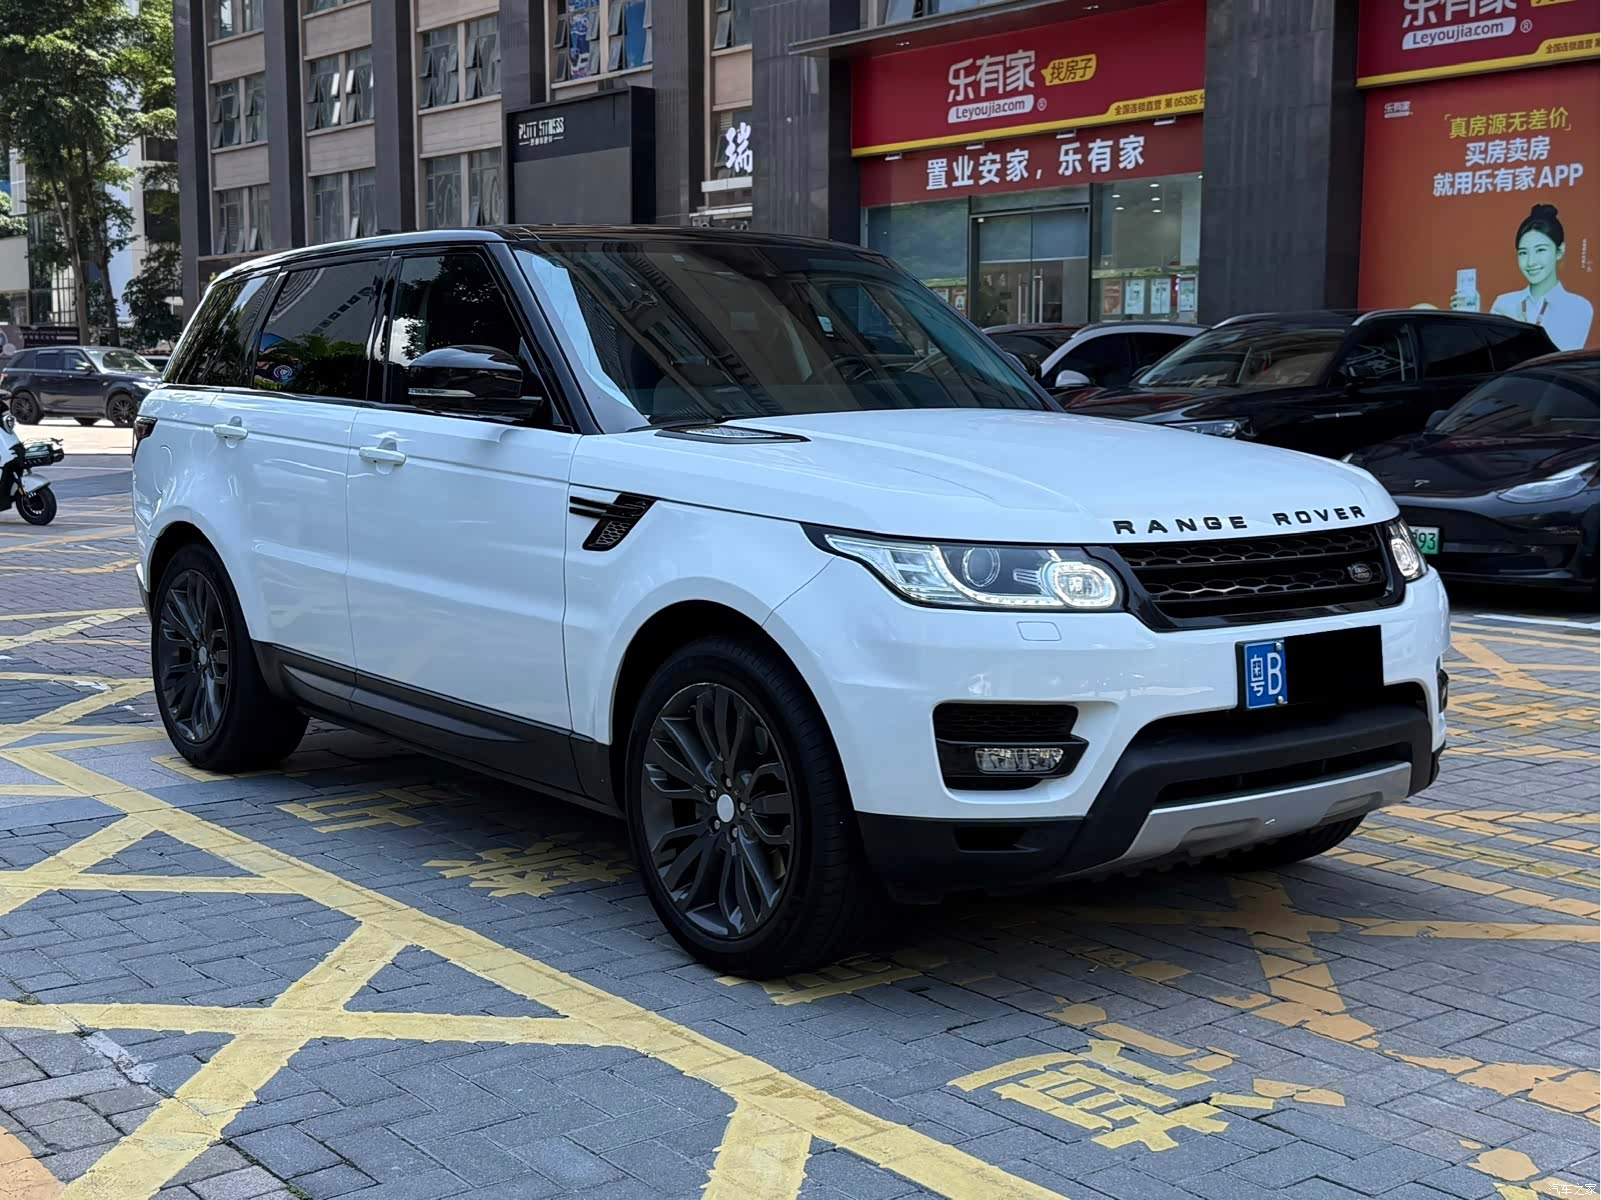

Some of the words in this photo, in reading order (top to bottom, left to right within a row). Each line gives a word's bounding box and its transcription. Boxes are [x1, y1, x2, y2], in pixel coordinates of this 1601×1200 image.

[1412, 20, 1504, 46] Leyoujia.com
[948, 49, 1036, 102] 乐有家
[1049, 57, 1094, 83] 找房子
[955, 100, 1025, 120] Leyoujia.com
[1465, 136, 1551, 167] 买房卖房
[1432, 163, 1584, 197] 就用乐有家APP
[1113, 516, 1247, 535] RANGE
[1272, 505, 1366, 526] ROVER
